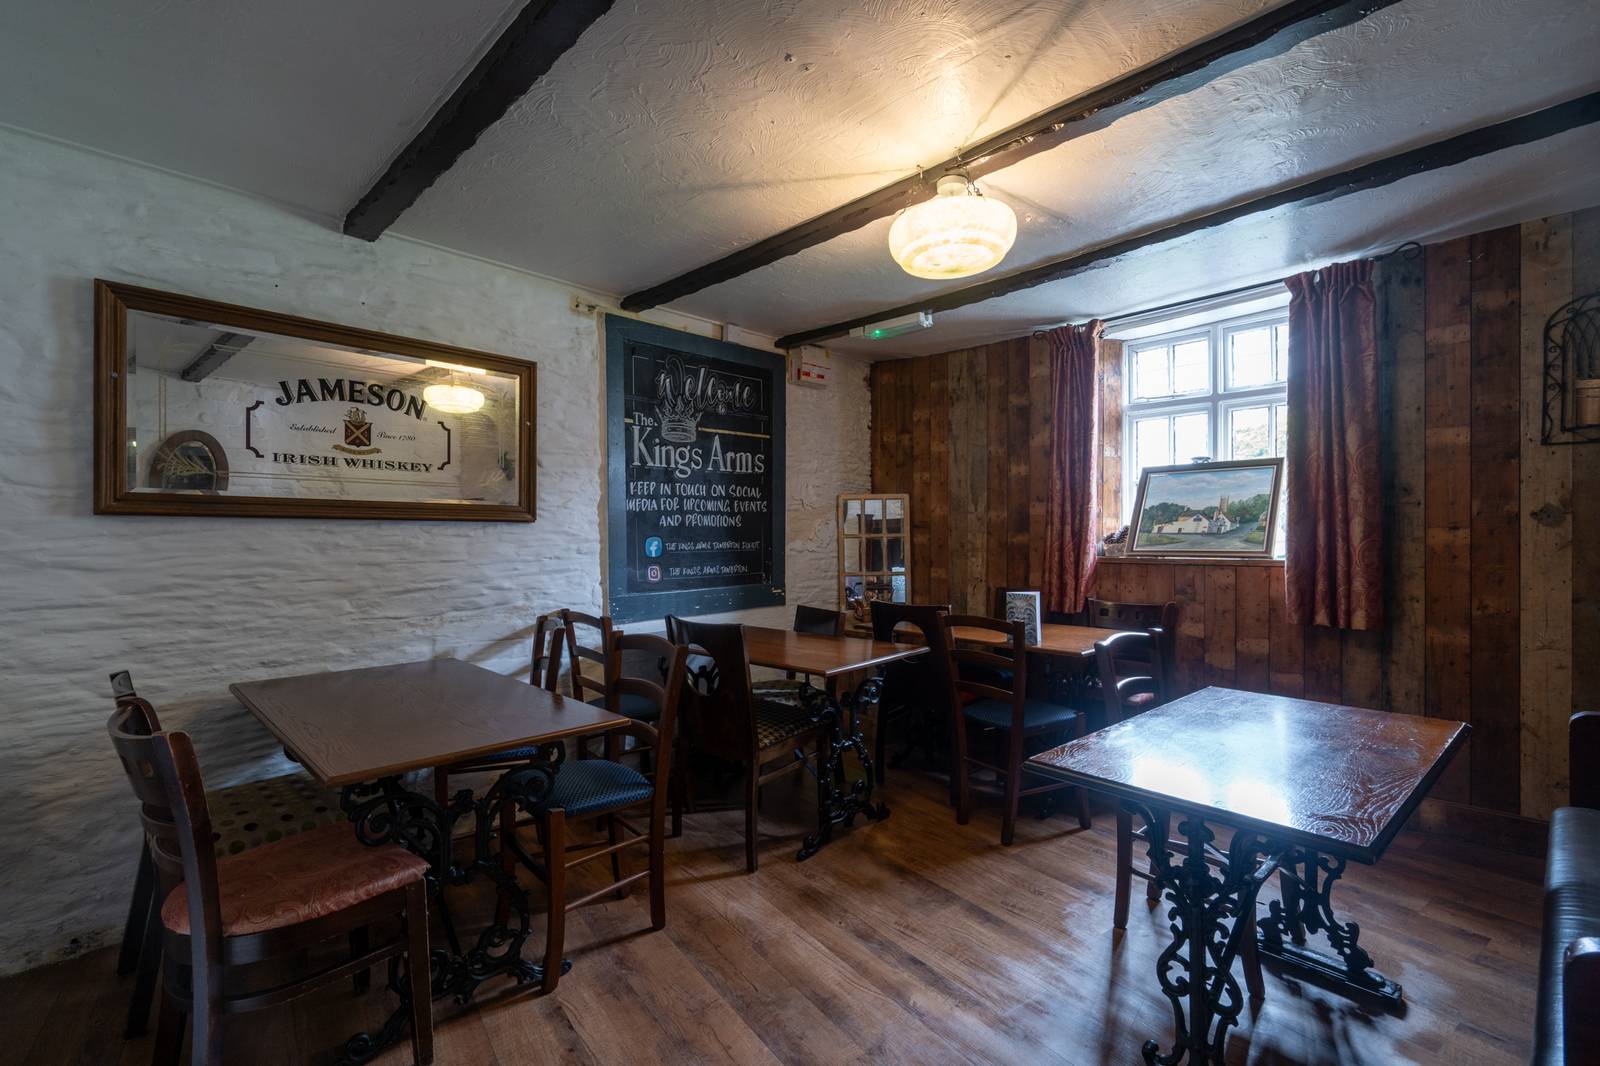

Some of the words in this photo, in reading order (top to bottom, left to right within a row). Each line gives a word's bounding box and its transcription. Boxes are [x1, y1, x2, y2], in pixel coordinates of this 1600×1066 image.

[656, 355, 755, 408] Welcome
[275, 378, 428, 421] JAMESON
[633, 411, 654, 426] The
[289, 423, 337, 434] Established
[376, 431, 397, 441] Since
[631, 425, 703, 479] Kings
[707, 434, 765, 474] Arms
[273, 452, 338, 467] IRISH
[344, 457, 434, 473] WHISKEY
[629, 481, 656, 496] KEEP
[660, 482, 672, 496] IN
[675, 482, 707, 497] TOUCH
[711, 484, 726, 497] ON
[729, 484, 762, 499] SOCIAL
[626, 498, 658, 512] MEDIA
[661, 497, 680, 511] FOR
[684, 498, 731, 513] UPCOMING
[734, 500, 768, 513] EVENTS
[659, 514, 682, 527] AND
[685, 513, 742, 528] PROMOTIONS
